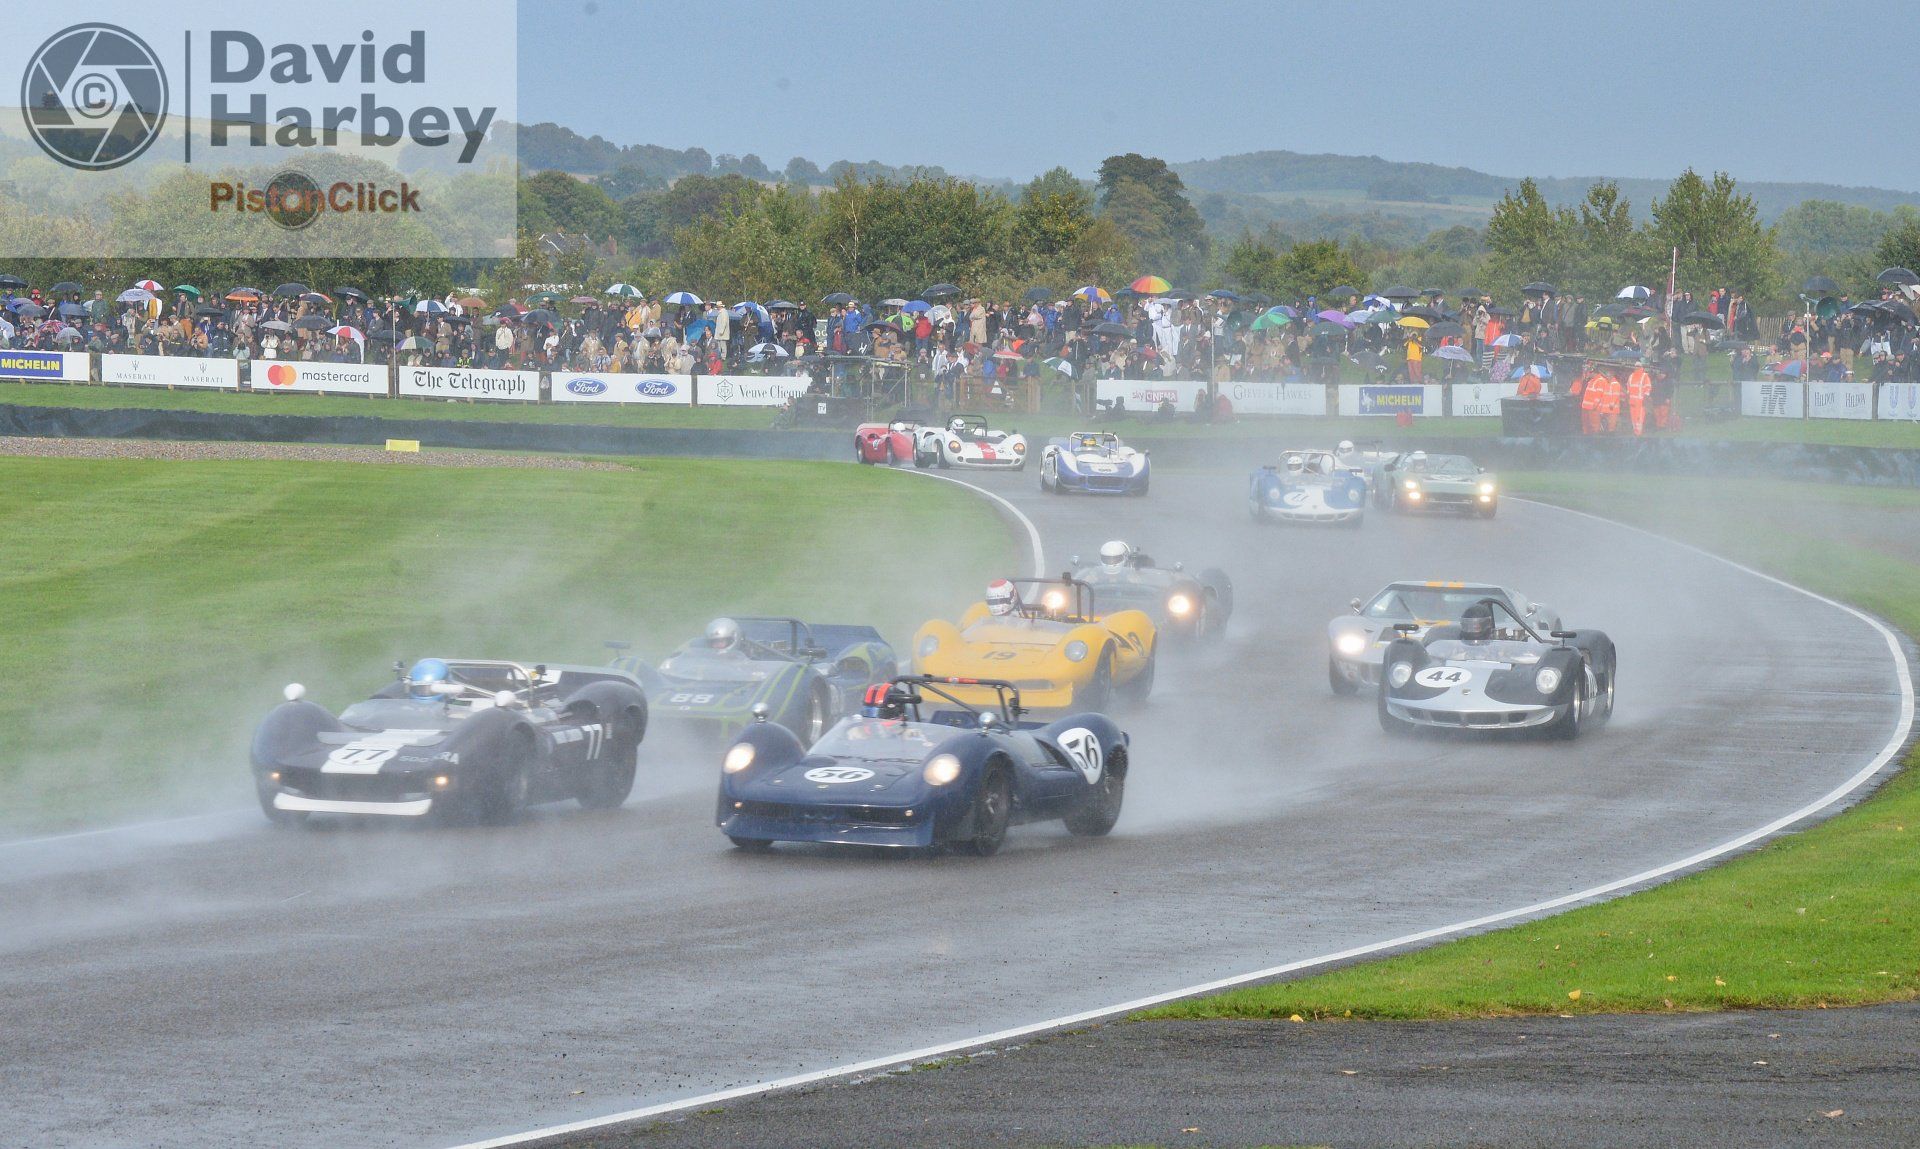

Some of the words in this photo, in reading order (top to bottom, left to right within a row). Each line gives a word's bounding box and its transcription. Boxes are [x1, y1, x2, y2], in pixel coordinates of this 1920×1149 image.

[1, 358, 60, 371] MICHELIN
[116, 372, 156, 380] MASERATI
[183, 375, 224, 383] MASERATI
[302, 370, 369, 383] mastercard
[414, 370, 443, 389] The
[448, 372, 526, 395] Telegraph
[573, 379, 600, 394] Ford
[643, 381, 670, 396] Ford
[739, 384, 767, 398] Veuve
[1376, 395, 1422, 406] MICHELIN
[1463, 404, 1491, 414] ROLEX
[982, 650, 1017, 660] 19
[1426, 670, 1462, 682] 44
[581, 723, 603, 760] 77
[341, 748, 390, 760] 77
[1065, 734, 1098, 770] 56
[811, 767, 869, 781] 56
